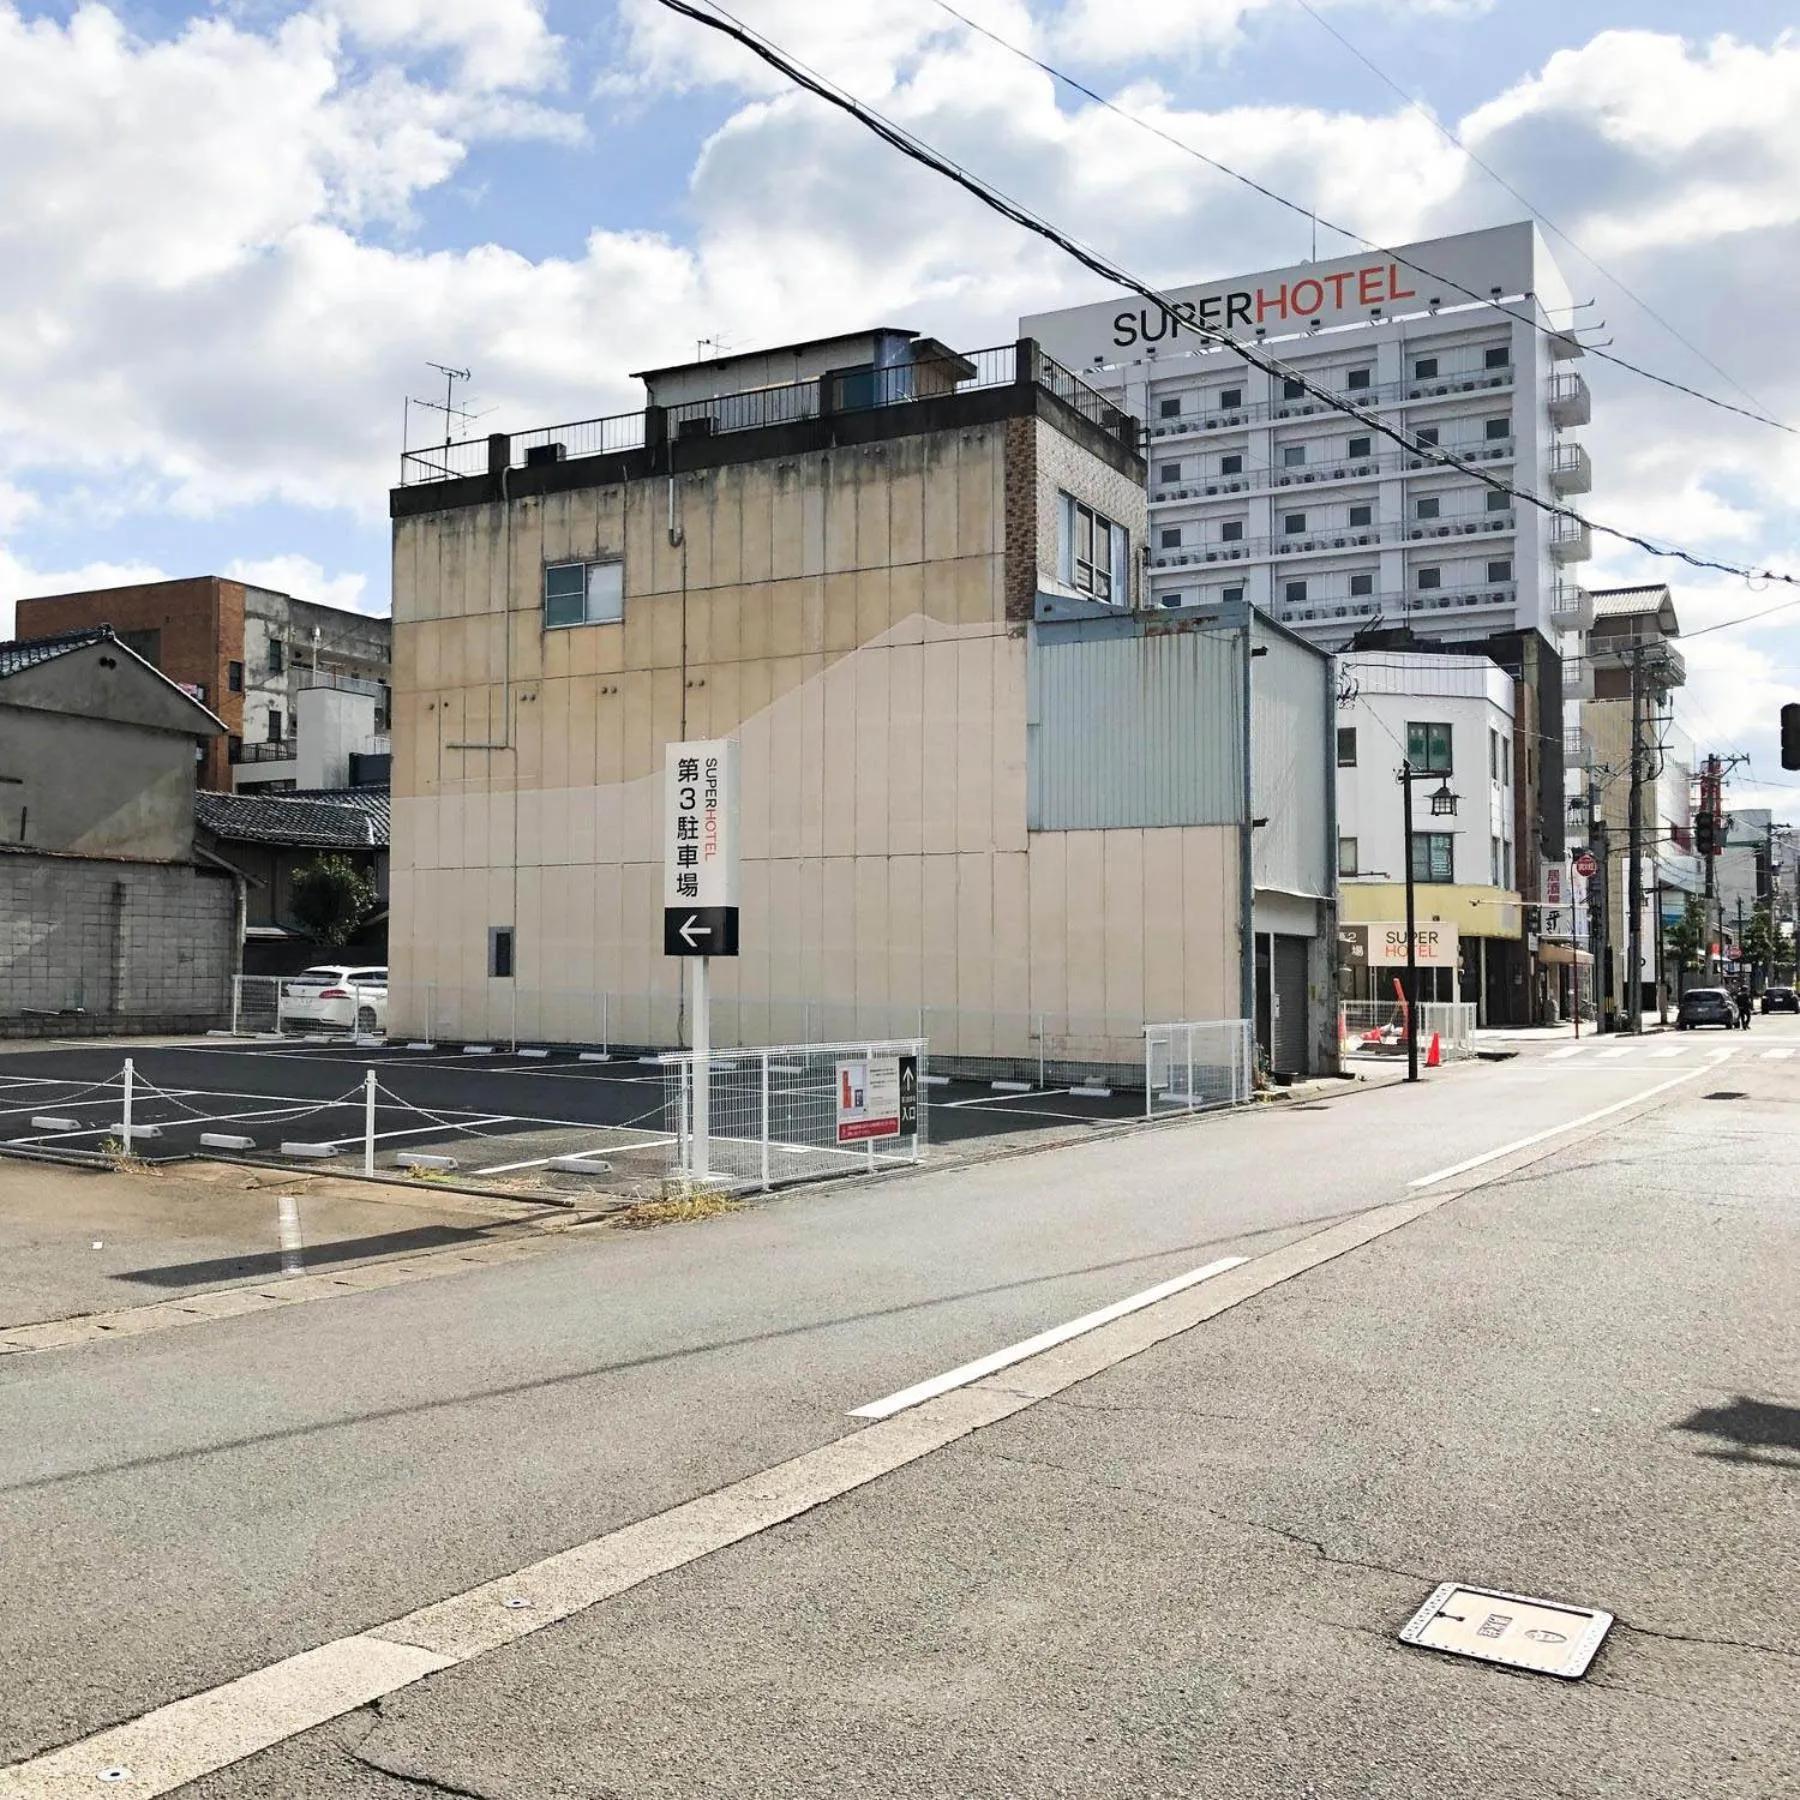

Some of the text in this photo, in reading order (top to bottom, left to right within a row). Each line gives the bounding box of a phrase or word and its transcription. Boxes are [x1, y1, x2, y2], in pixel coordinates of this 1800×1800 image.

[676, 758, 699, 897] 第3駐車場
[1386, 931, 1438, 944] SUER
[1385, 944, 1437, 957] HOEL
[902, 1106, 916, 1121] 入口
